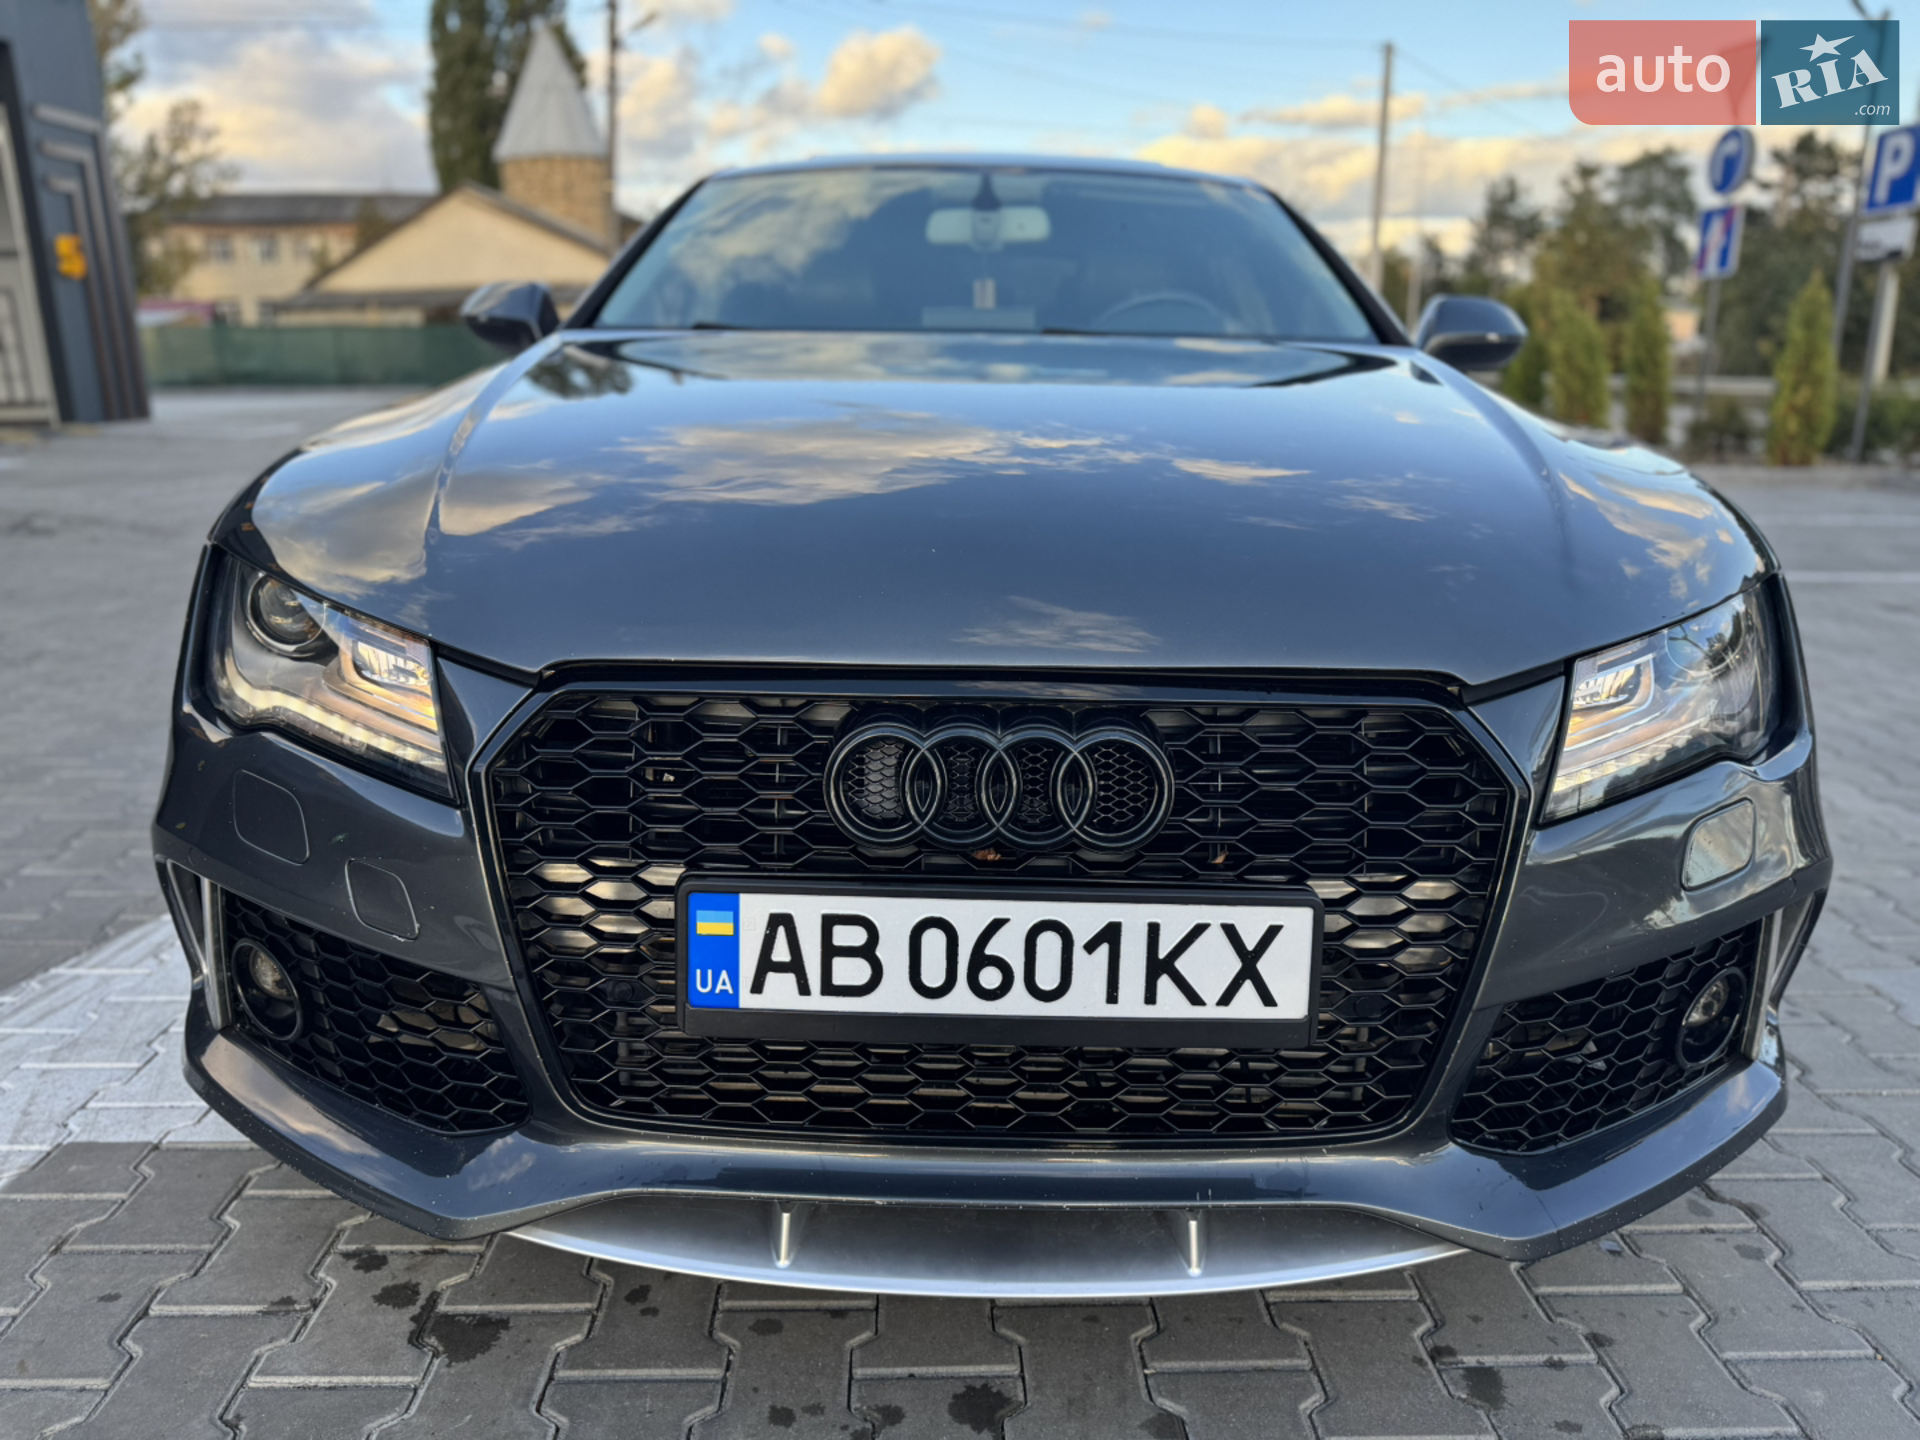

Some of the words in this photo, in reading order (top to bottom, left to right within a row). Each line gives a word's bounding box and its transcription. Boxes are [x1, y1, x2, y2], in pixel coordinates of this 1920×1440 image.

[1872, 132, 1915, 205] P
[695, 968, 734, 995] UA
[750, 912, 884, 998] AB
[908, 916, 1122, 1005] 0601
[1144, 921, 1285, 1007] KX
